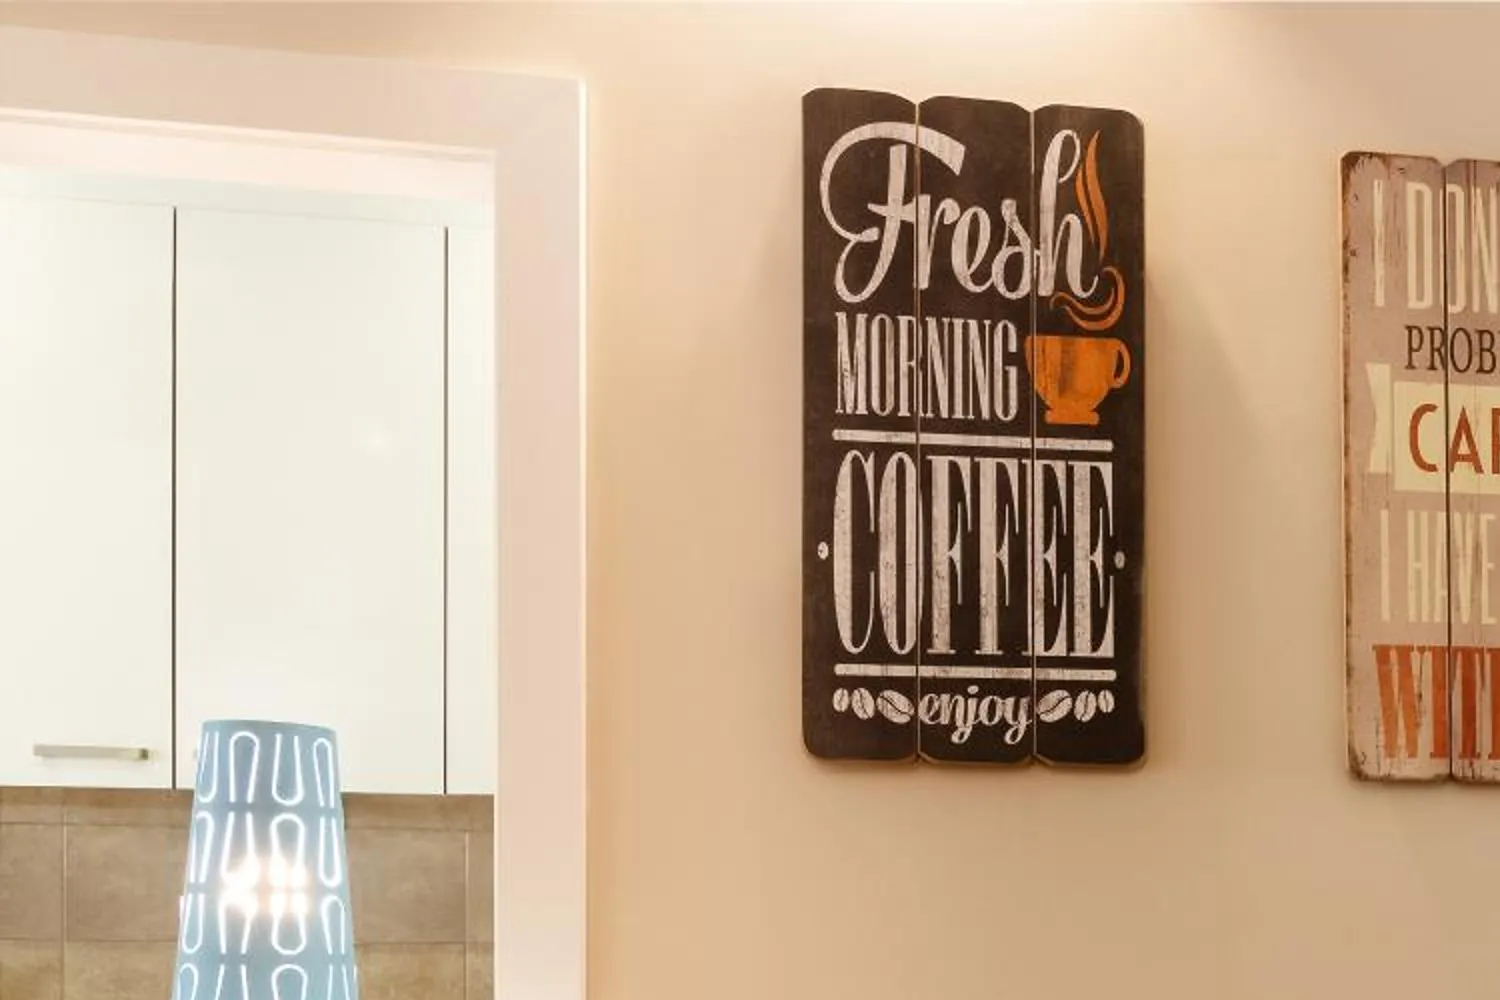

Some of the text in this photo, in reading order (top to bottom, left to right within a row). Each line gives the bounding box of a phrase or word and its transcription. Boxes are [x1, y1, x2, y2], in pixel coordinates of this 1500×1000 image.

[820, 121, 1099, 303] Fresh
[1372, 178, 1386, 308] I
[835, 311, 1019, 422] MORNING
[833, 449, 1115, 658] COFFEE
[1379, 509, 1391, 623] I
[1407, 510, 1498, 626] HAVE
[918, 685, 1032, 745] enjoy
